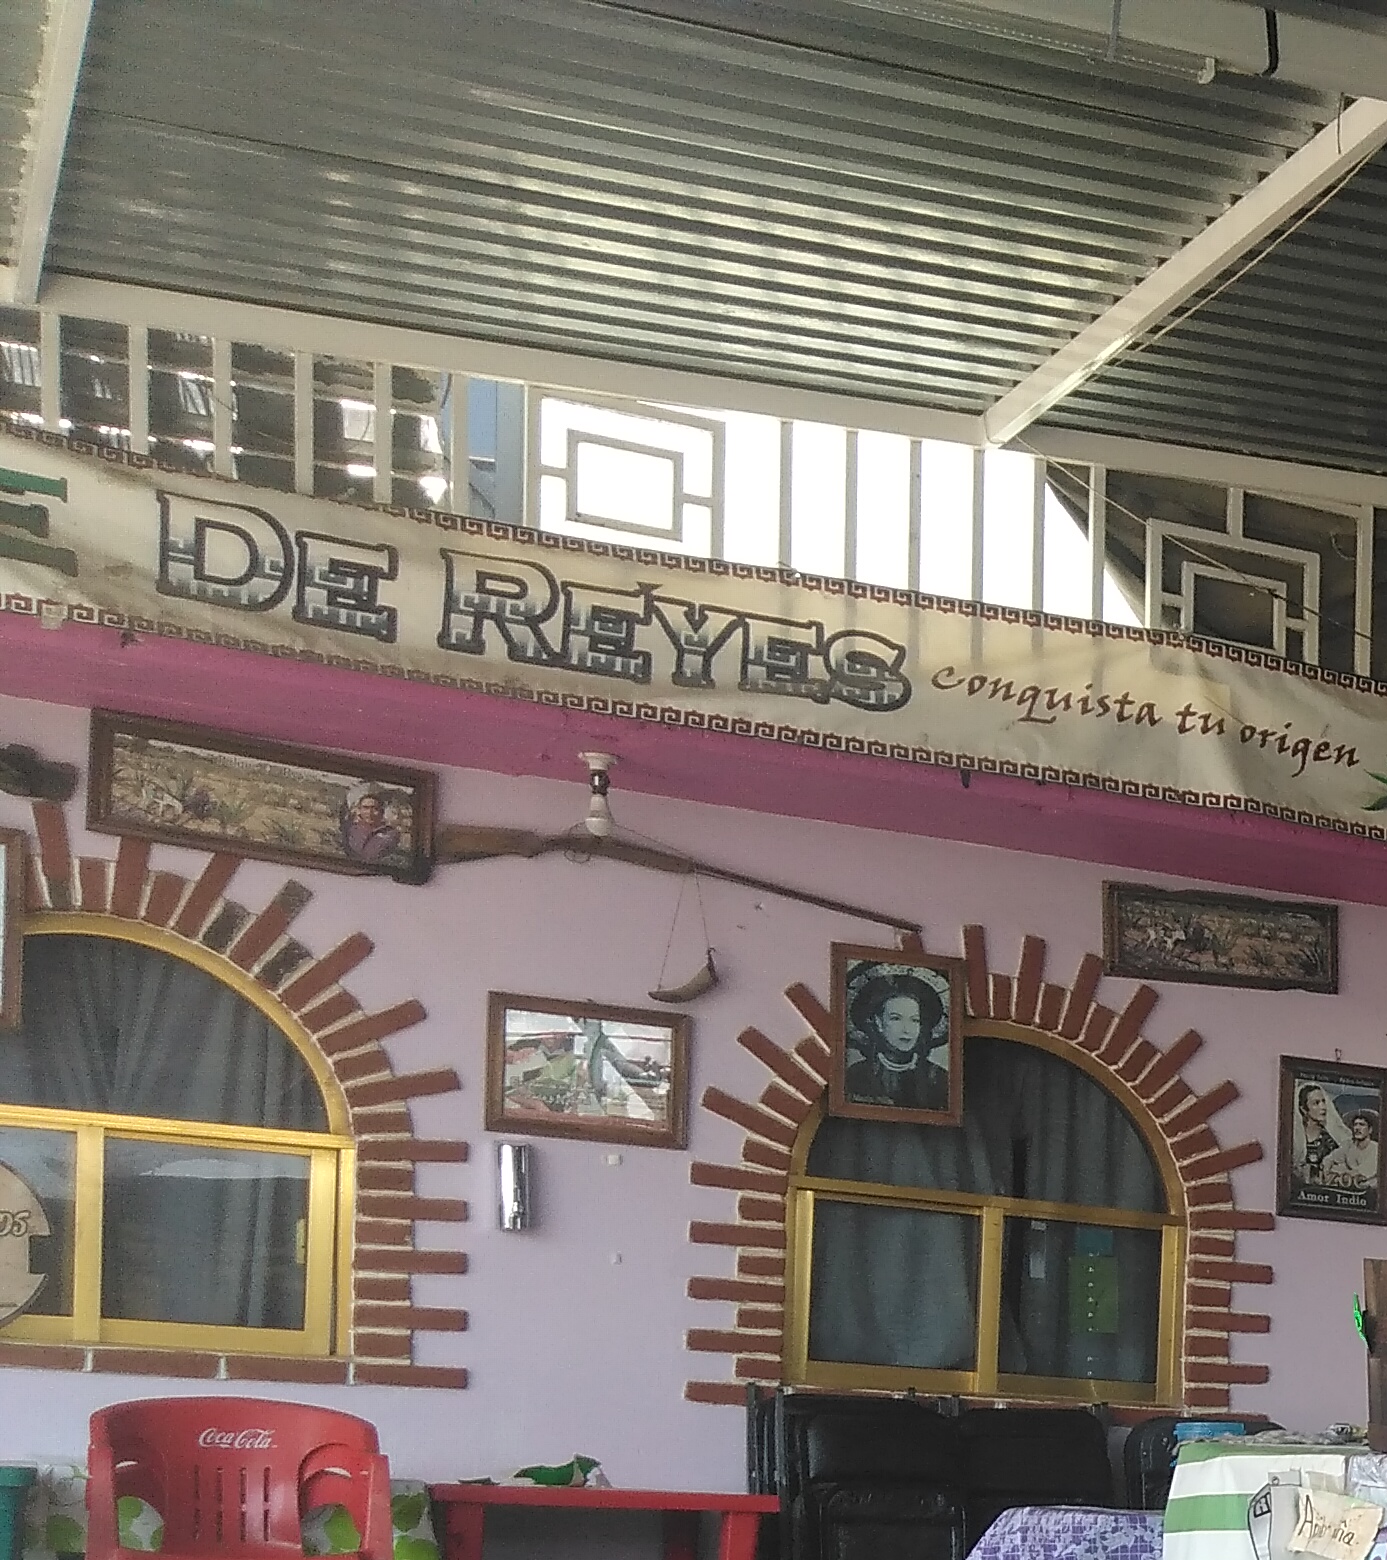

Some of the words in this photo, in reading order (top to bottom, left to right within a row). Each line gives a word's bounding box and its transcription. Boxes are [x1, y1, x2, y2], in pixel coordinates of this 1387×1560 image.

[156, 489, 400, 644] DE
[437, 547, 913, 713] REYES
[1176, 701, 1227, 737] tu
[1239, 720, 1360, 778] origen
[1297, 1189, 1330, 1203] Amor
[1336, 1193, 1368, 1207] Indio
